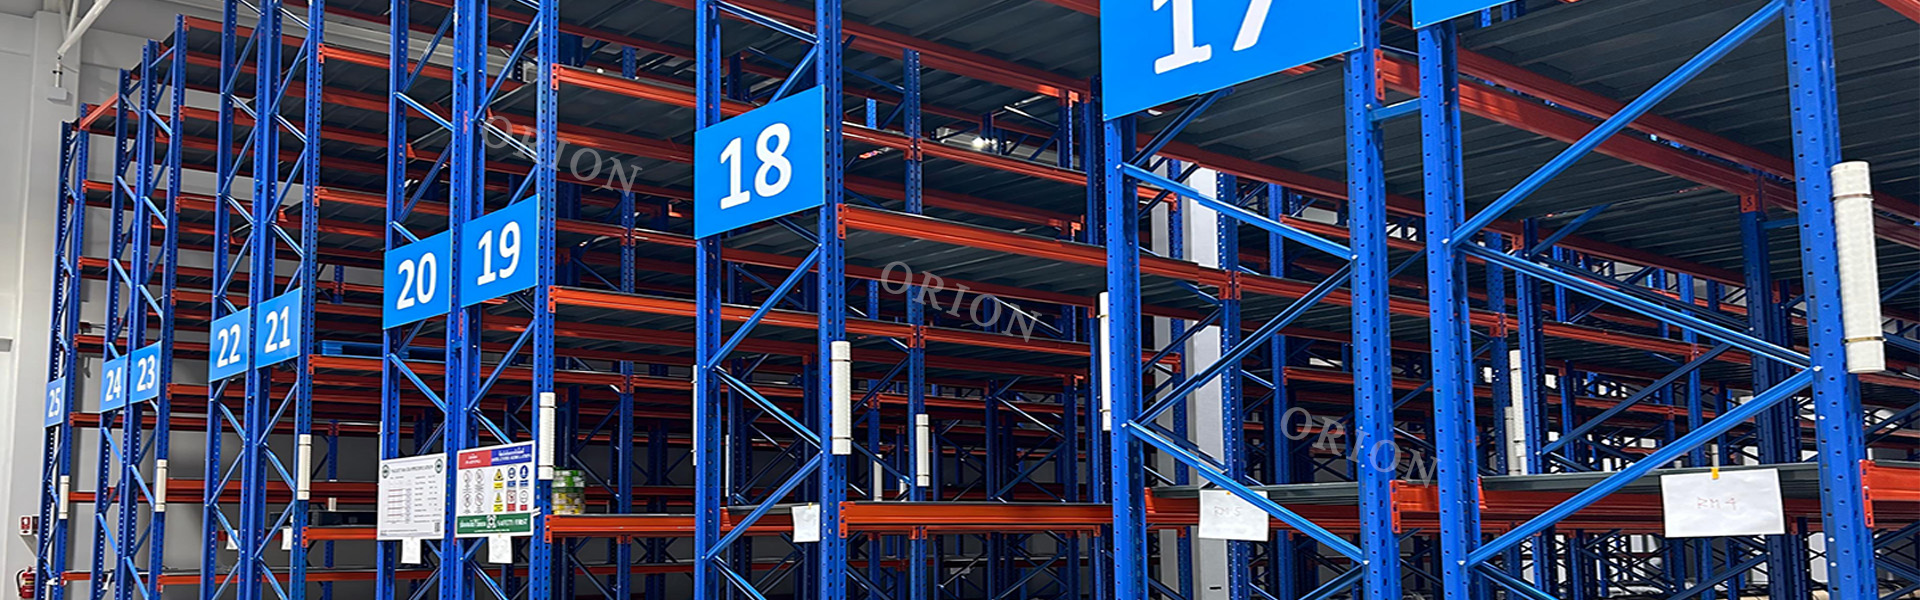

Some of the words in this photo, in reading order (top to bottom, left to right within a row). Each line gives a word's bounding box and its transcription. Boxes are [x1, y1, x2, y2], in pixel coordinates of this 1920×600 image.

[720, 122, 792, 210] 18
[477, 221, 521, 286] 19
[396, 252, 437, 310] 20
[216, 323, 241, 368] 22
[264, 305, 291, 354] 21
[104, 366, 122, 402] 24
[136, 354, 156, 392] 23
[48, 386, 61, 418] 25
